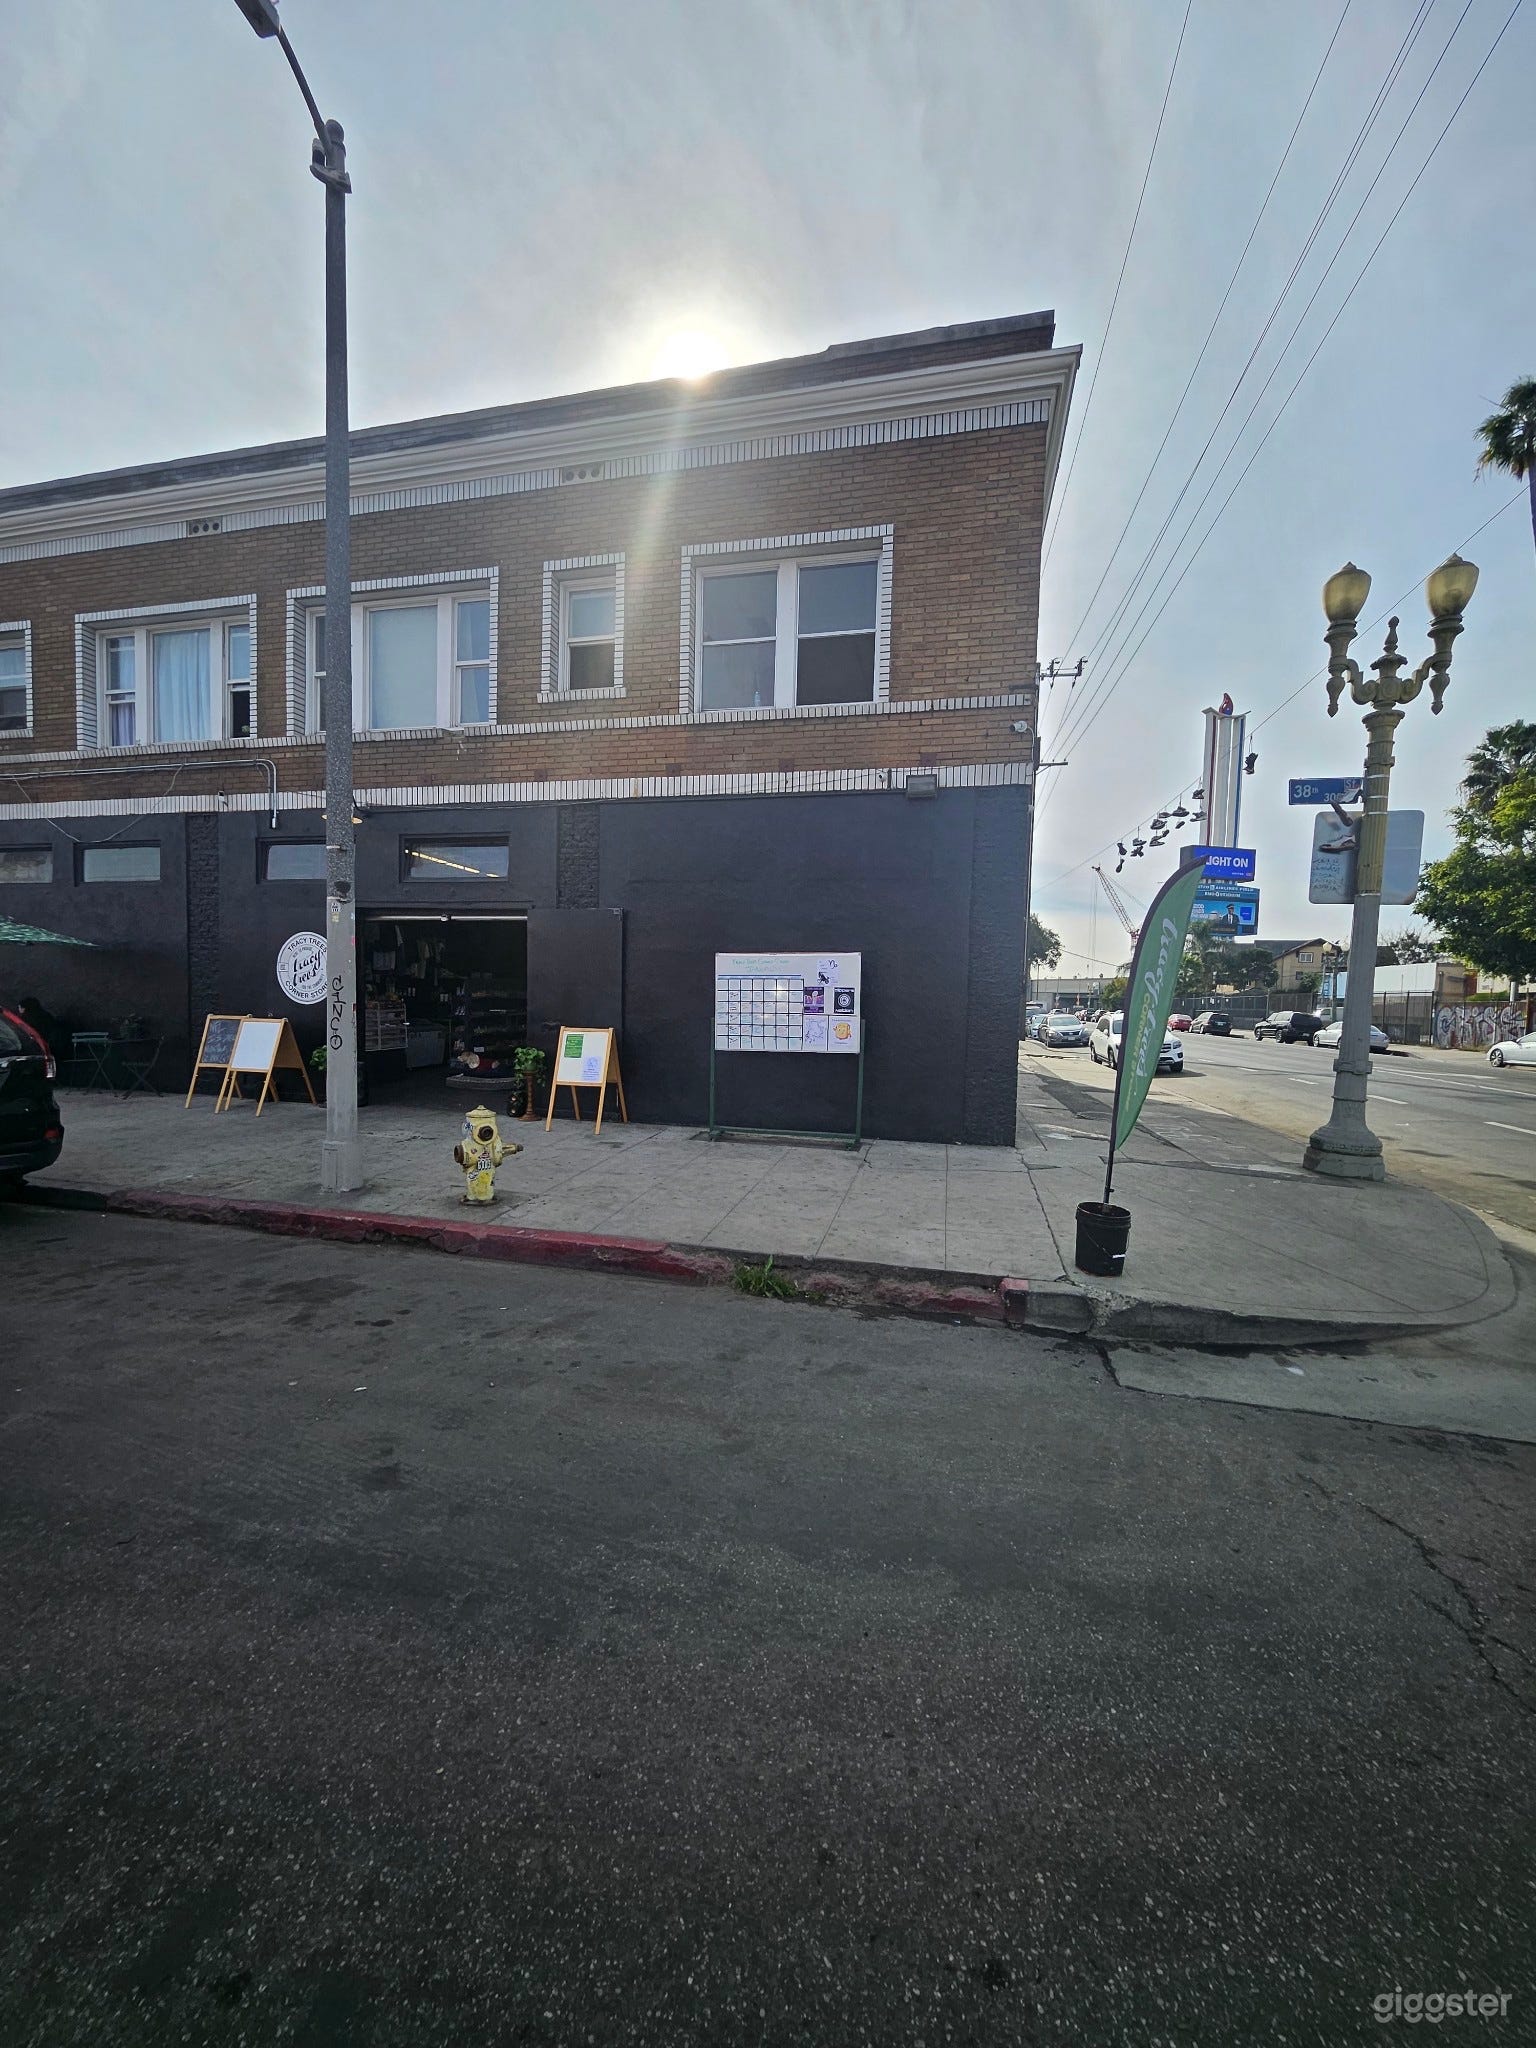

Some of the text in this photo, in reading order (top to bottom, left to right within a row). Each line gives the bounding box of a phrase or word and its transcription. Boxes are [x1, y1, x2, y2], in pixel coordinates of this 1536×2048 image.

[1293, 780, 1357, 799] 38th St
[1233, 857, 1248, 868] ON
[287, 937, 308, 952] TRACY
[309, 937, 327, 953] TREES
[285, 980, 309, 999] CORNER
